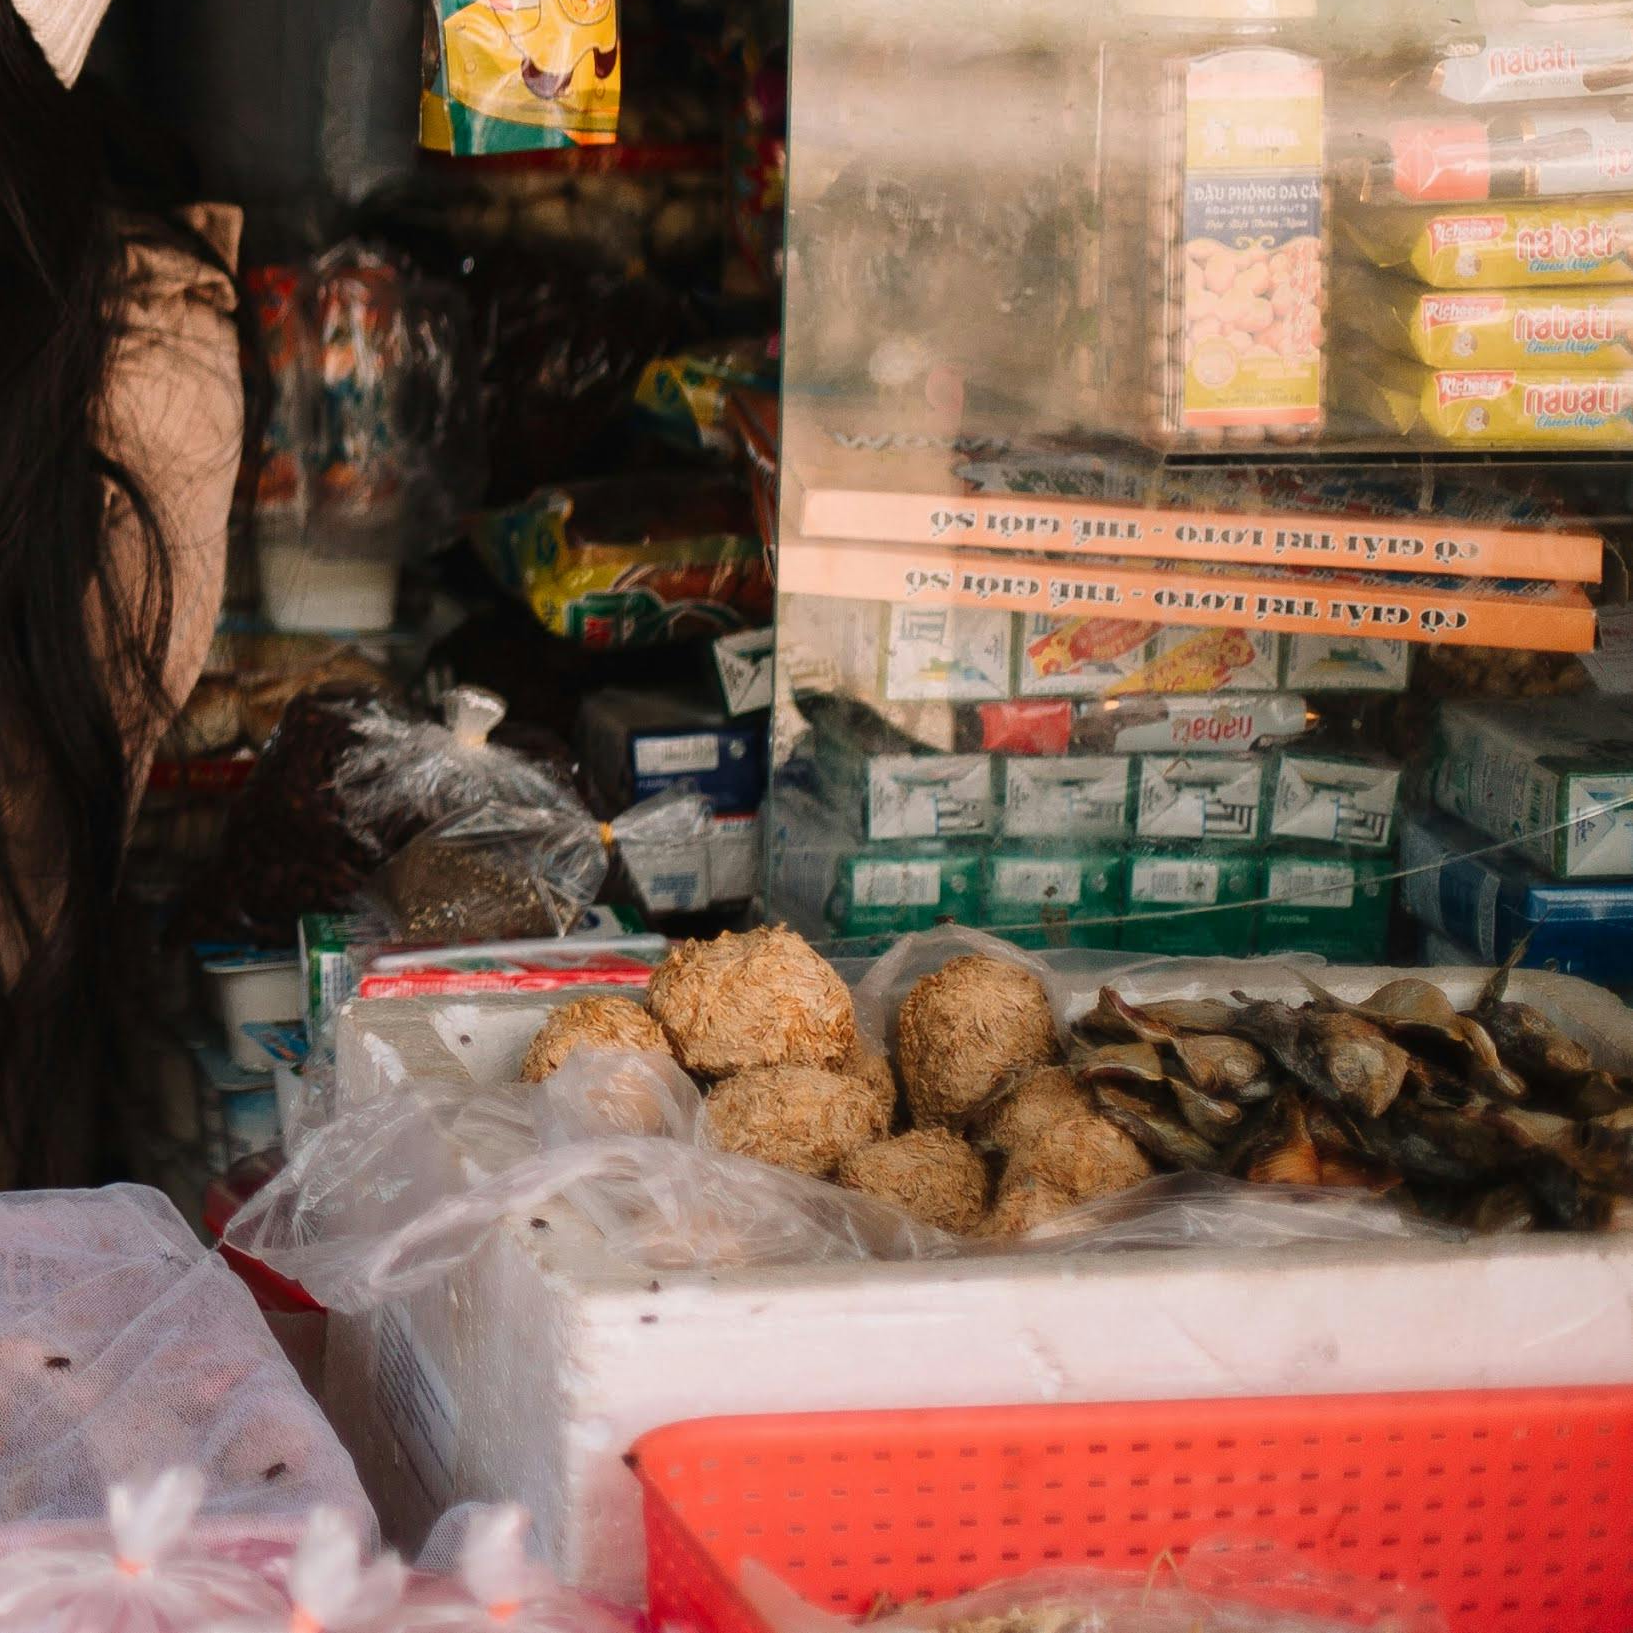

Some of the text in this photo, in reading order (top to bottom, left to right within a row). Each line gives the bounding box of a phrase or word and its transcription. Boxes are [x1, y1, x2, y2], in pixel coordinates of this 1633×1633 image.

[1489, 40, 1577, 79] nabati
[1517, 221, 1615, 261] nabati
[1514, 303, 1614, 342] nabati
[1524, 379, 1621, 415] nabati
[1171, 712, 1253, 743] nabati
